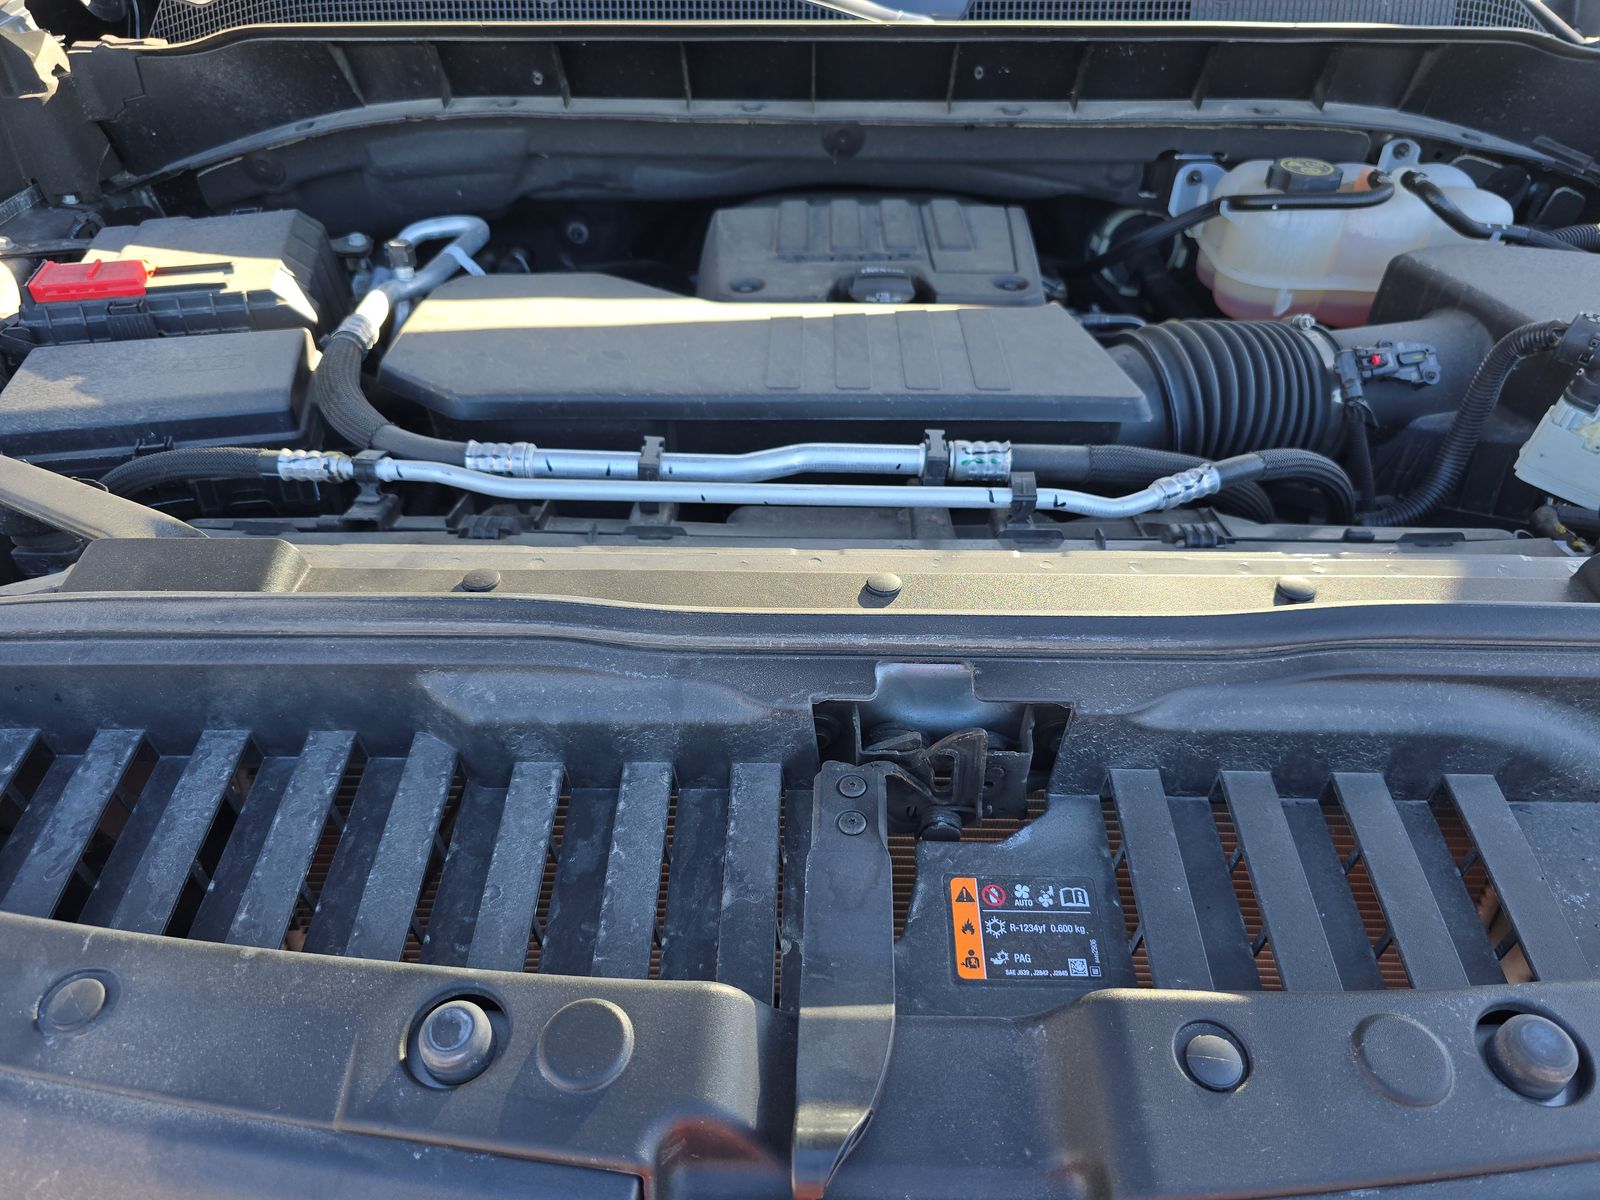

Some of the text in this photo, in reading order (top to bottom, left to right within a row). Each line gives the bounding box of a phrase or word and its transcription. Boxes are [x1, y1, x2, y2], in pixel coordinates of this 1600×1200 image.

[1014, 899, 1033, 907] AUTO
[1009, 923, 1046, 934] R-1234yf
[1050, 924, 1073, 933] 0.600
[1014, 953, 1031, 963] PAG
